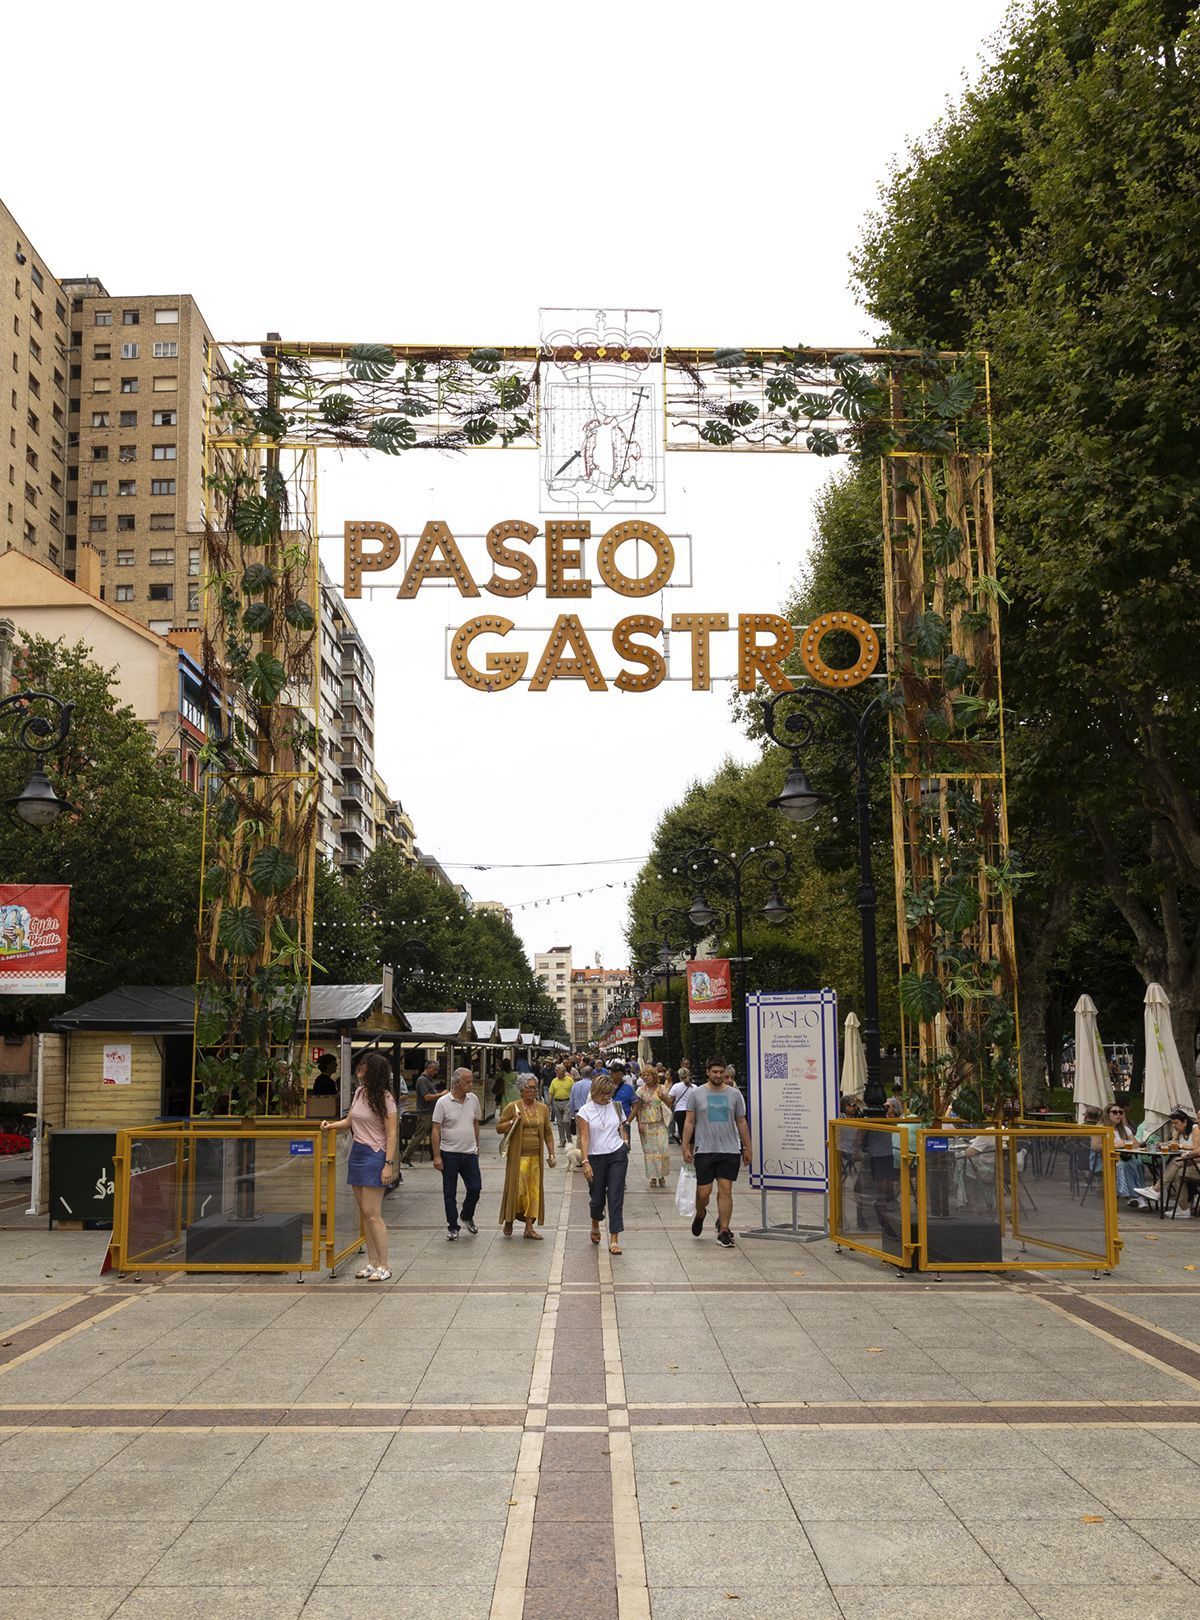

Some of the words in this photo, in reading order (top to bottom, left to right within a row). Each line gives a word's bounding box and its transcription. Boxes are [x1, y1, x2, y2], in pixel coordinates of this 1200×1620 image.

[344, 519, 675, 599] PASEO
[450, 611, 880, 692] GASTRO
[27, 932, 62, 948] Bonito
[762, 1009, 820, 1029] PASEO
[763, 1158, 825, 1176] GASTRO
